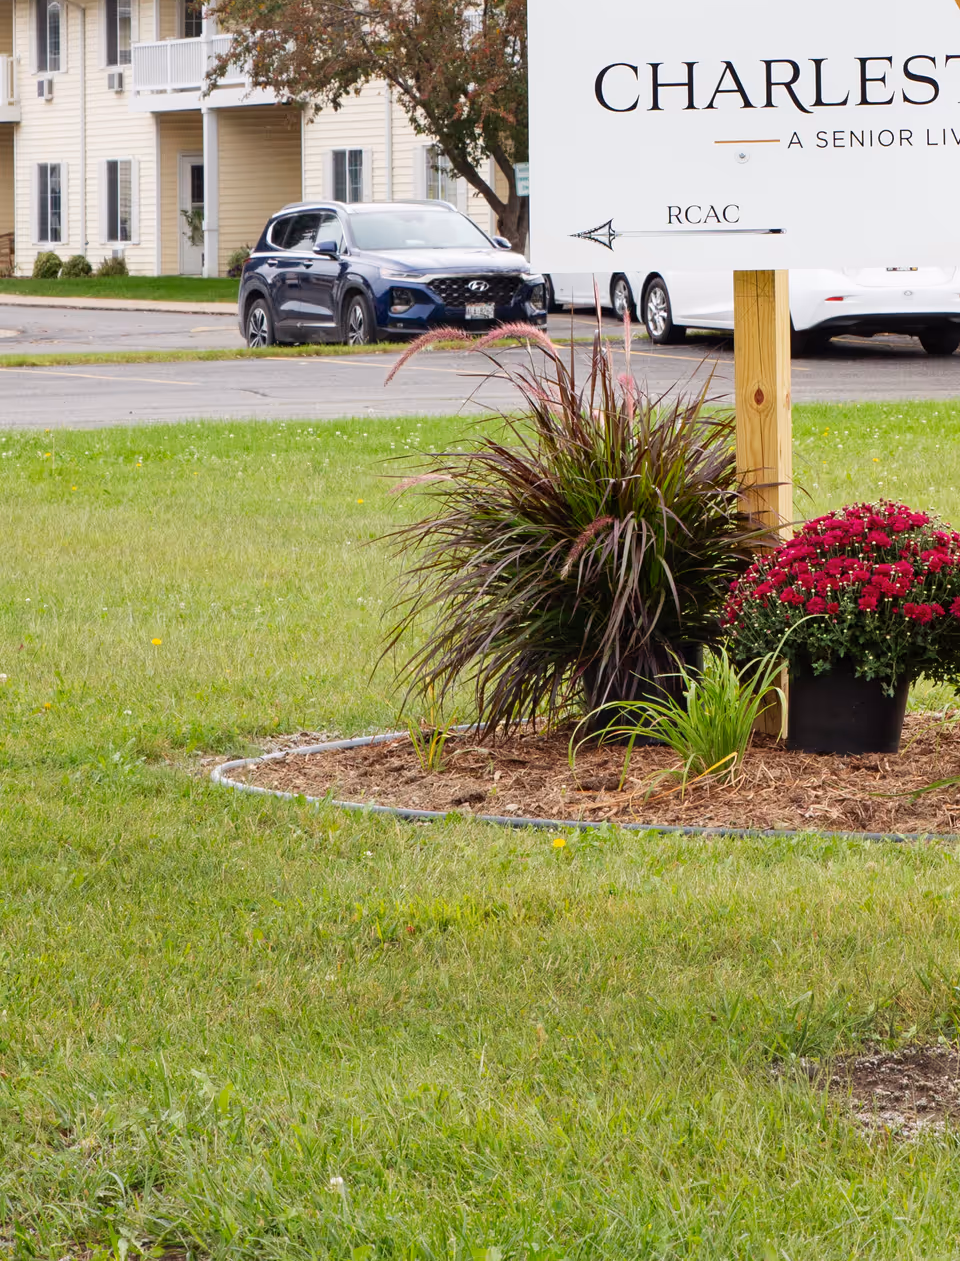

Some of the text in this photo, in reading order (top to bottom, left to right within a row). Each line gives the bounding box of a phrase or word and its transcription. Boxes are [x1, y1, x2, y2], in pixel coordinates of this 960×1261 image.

[787, 131, 804, 150] A
[815, 127, 914, 148] SENIOR
[666, 204, 740, 225] RCAC
